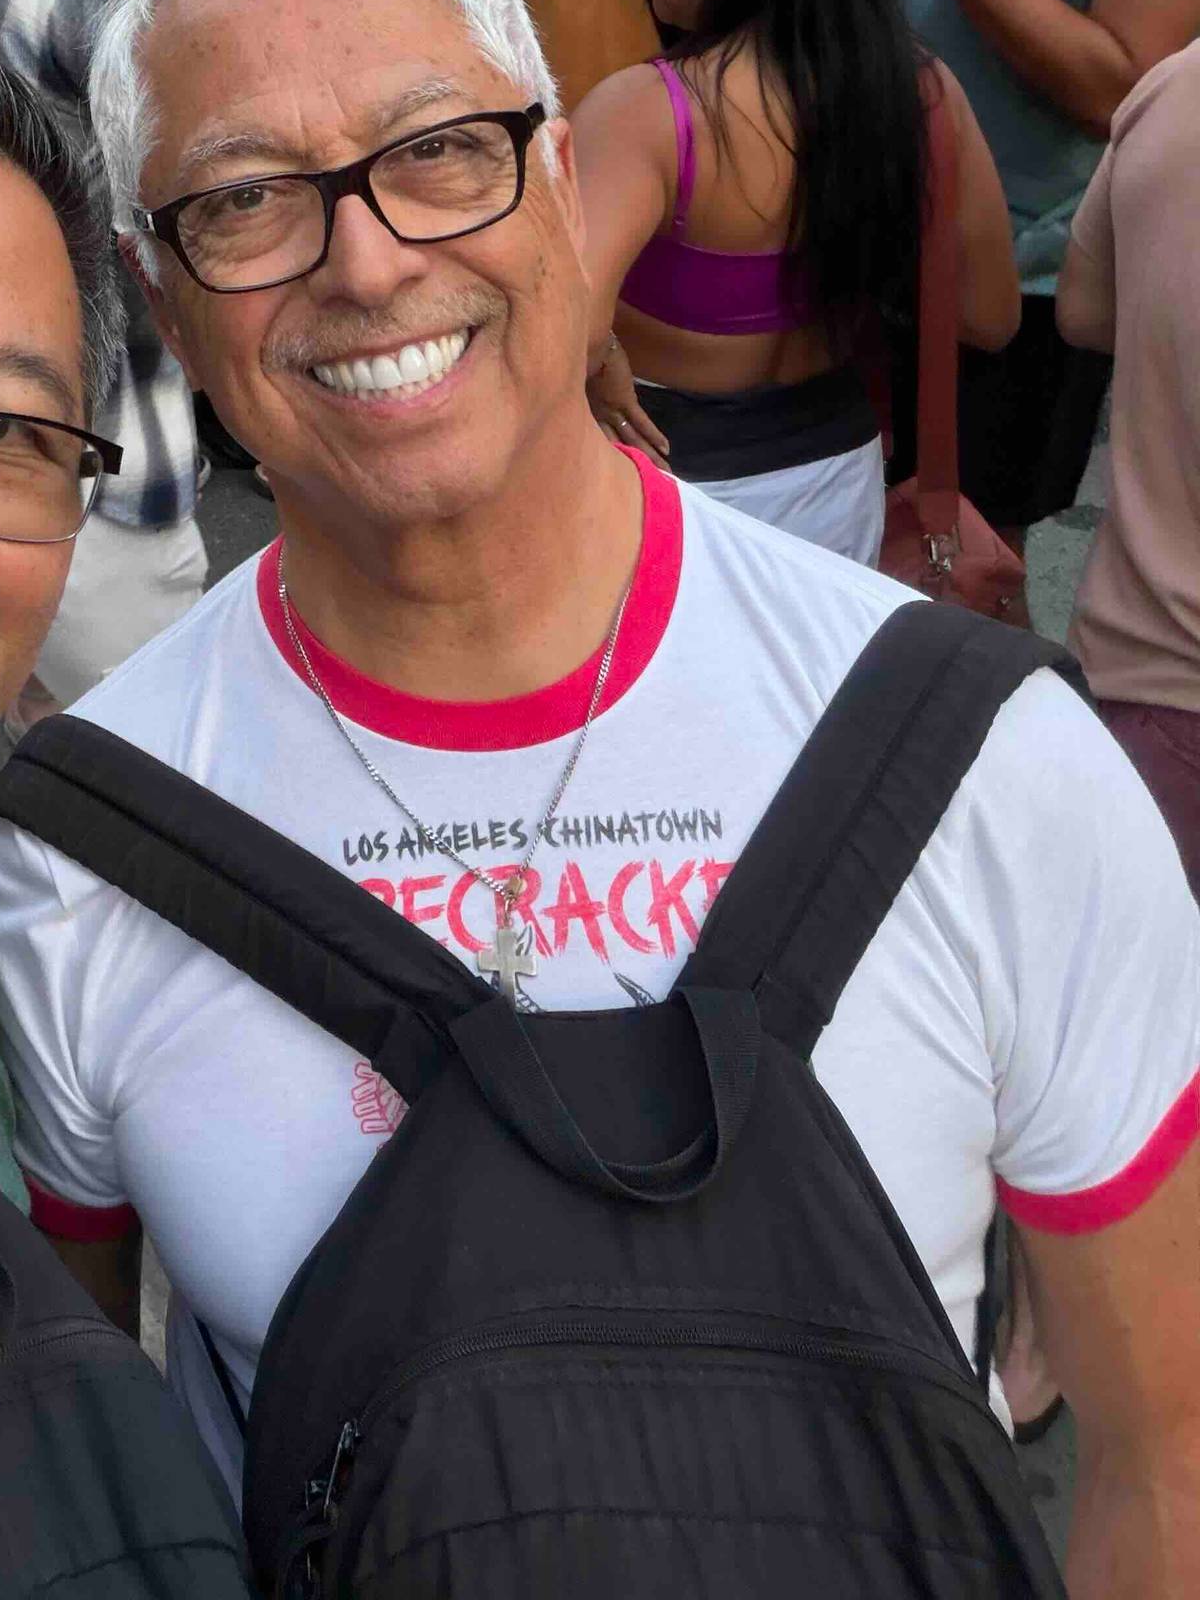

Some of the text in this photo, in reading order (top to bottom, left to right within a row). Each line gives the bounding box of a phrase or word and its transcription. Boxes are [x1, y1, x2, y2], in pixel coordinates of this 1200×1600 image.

[342, 808, 723, 866] LOS ANGELES CHINATOWN
